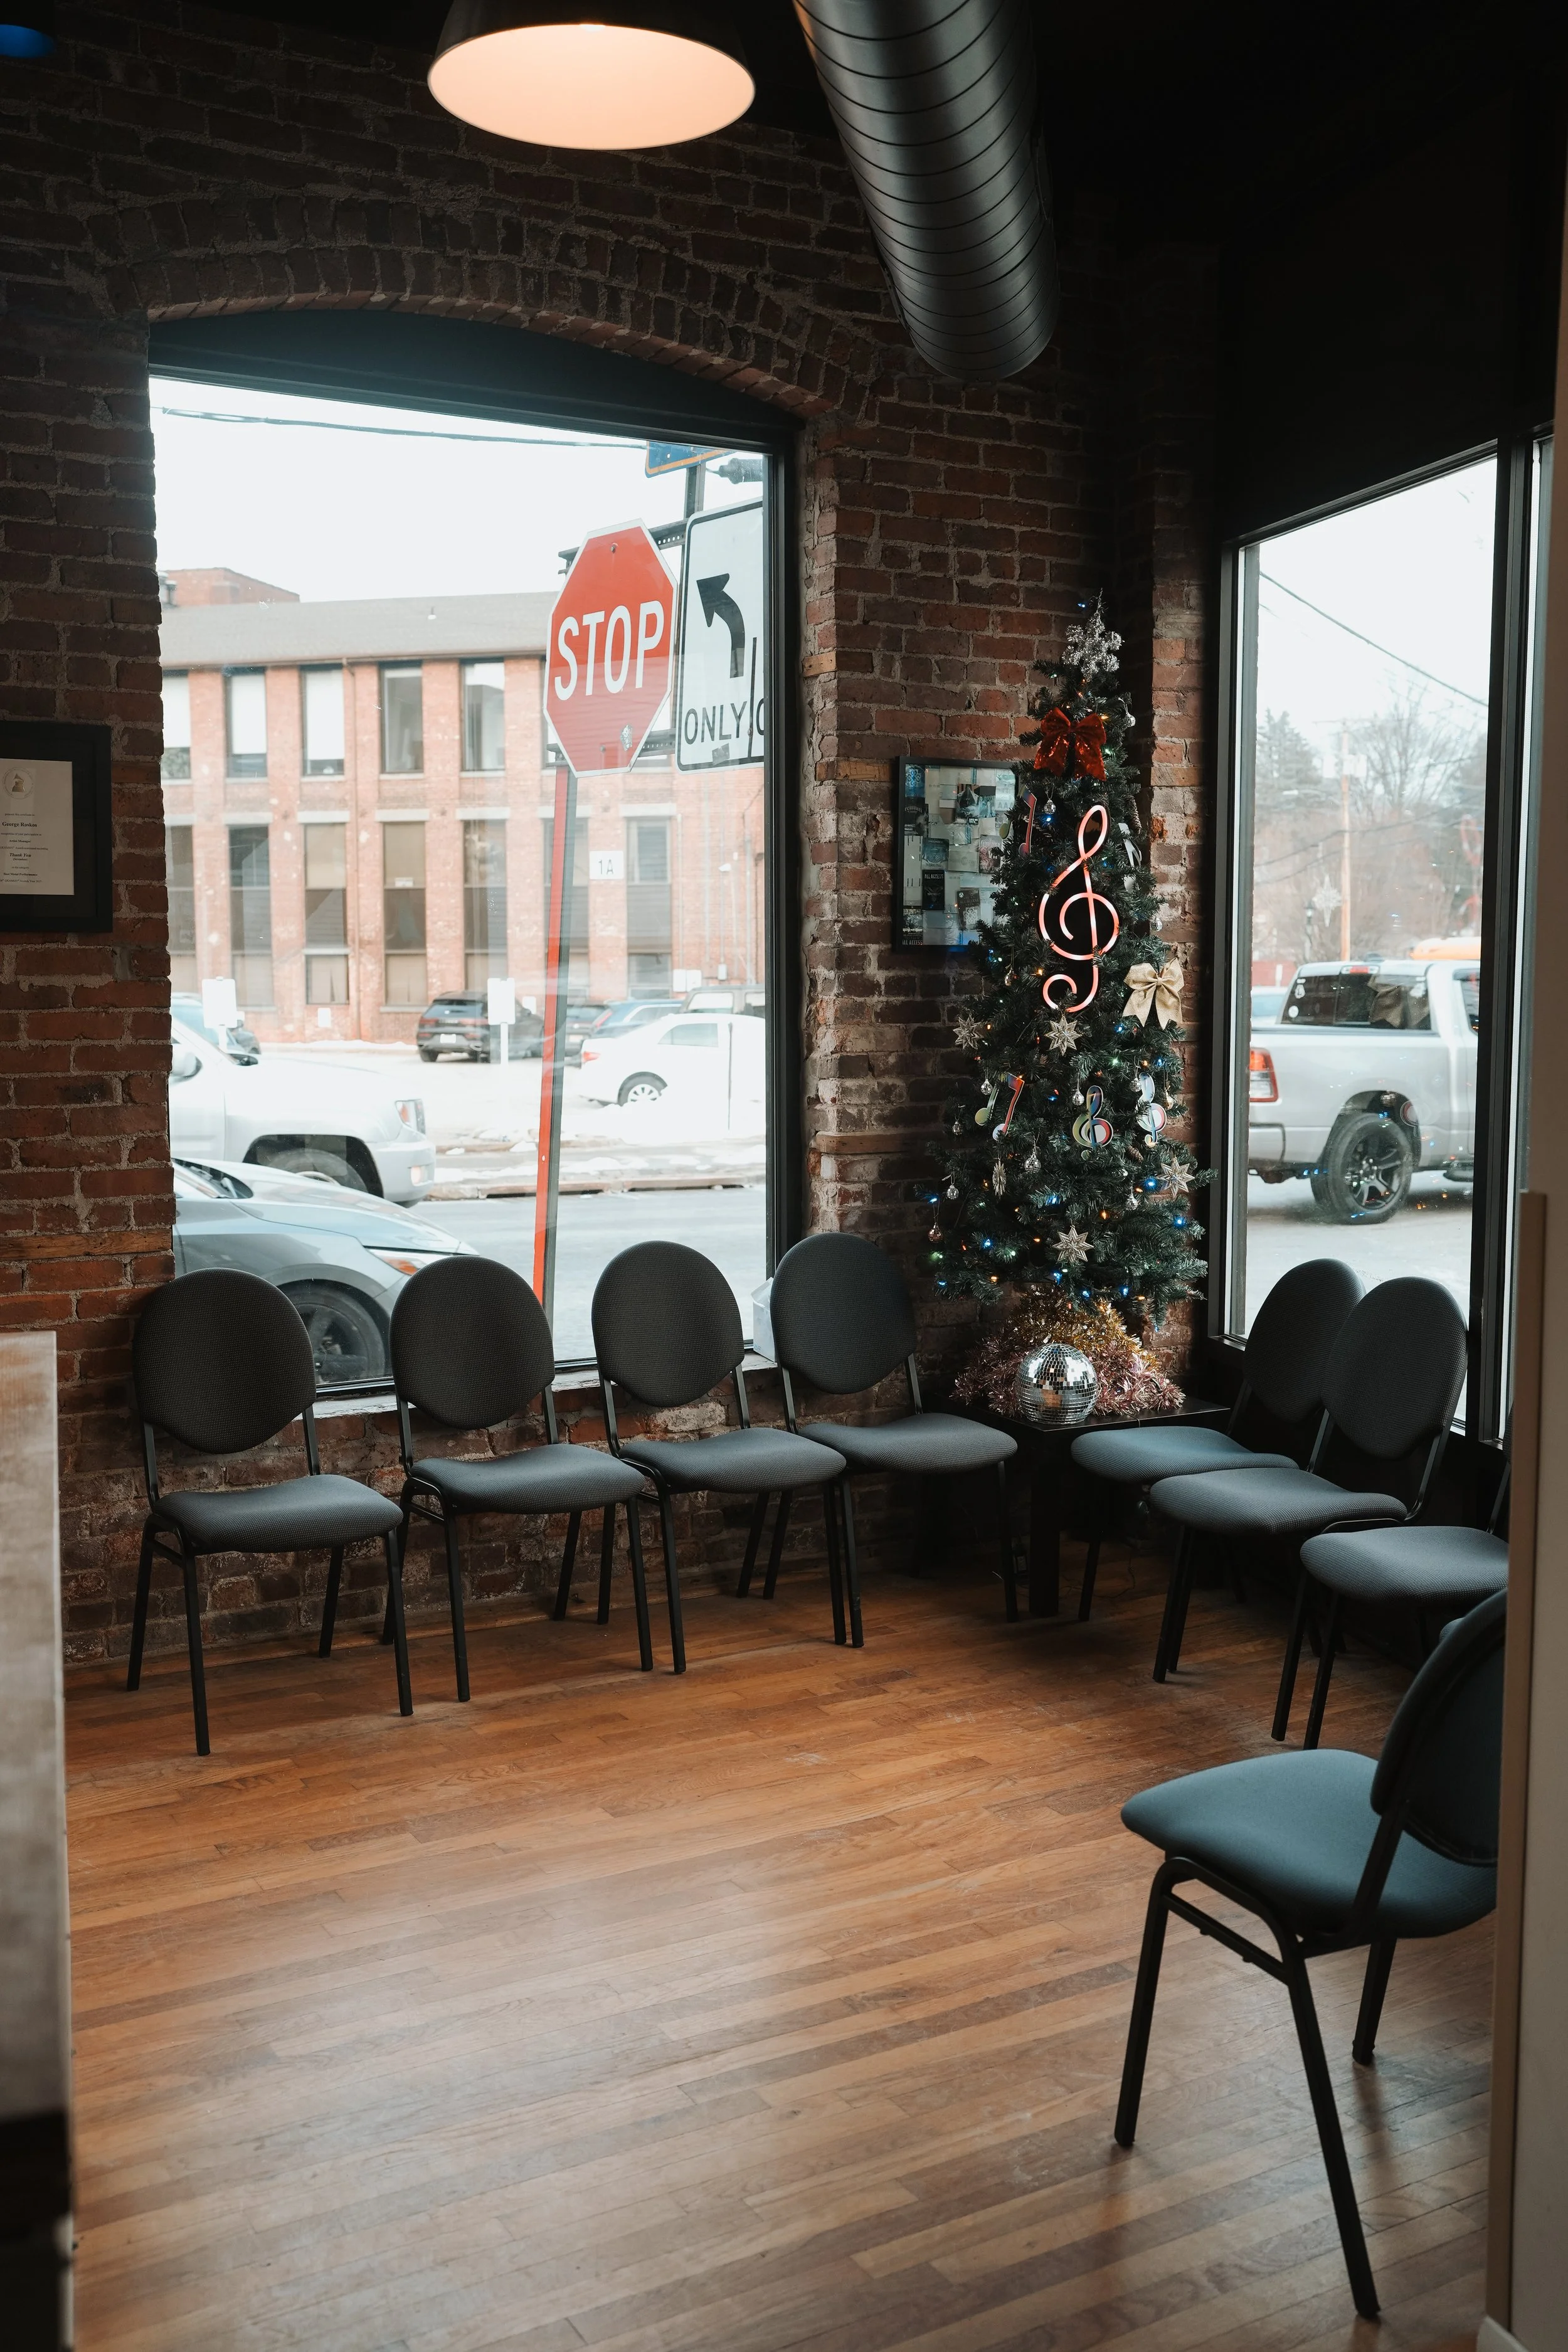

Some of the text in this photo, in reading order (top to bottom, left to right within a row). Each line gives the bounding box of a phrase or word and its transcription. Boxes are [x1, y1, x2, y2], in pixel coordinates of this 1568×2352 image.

[554, 600, 664, 701] STOP
[684, 701, 747, 744] ONLY
[598, 859, 613, 875] 1A
